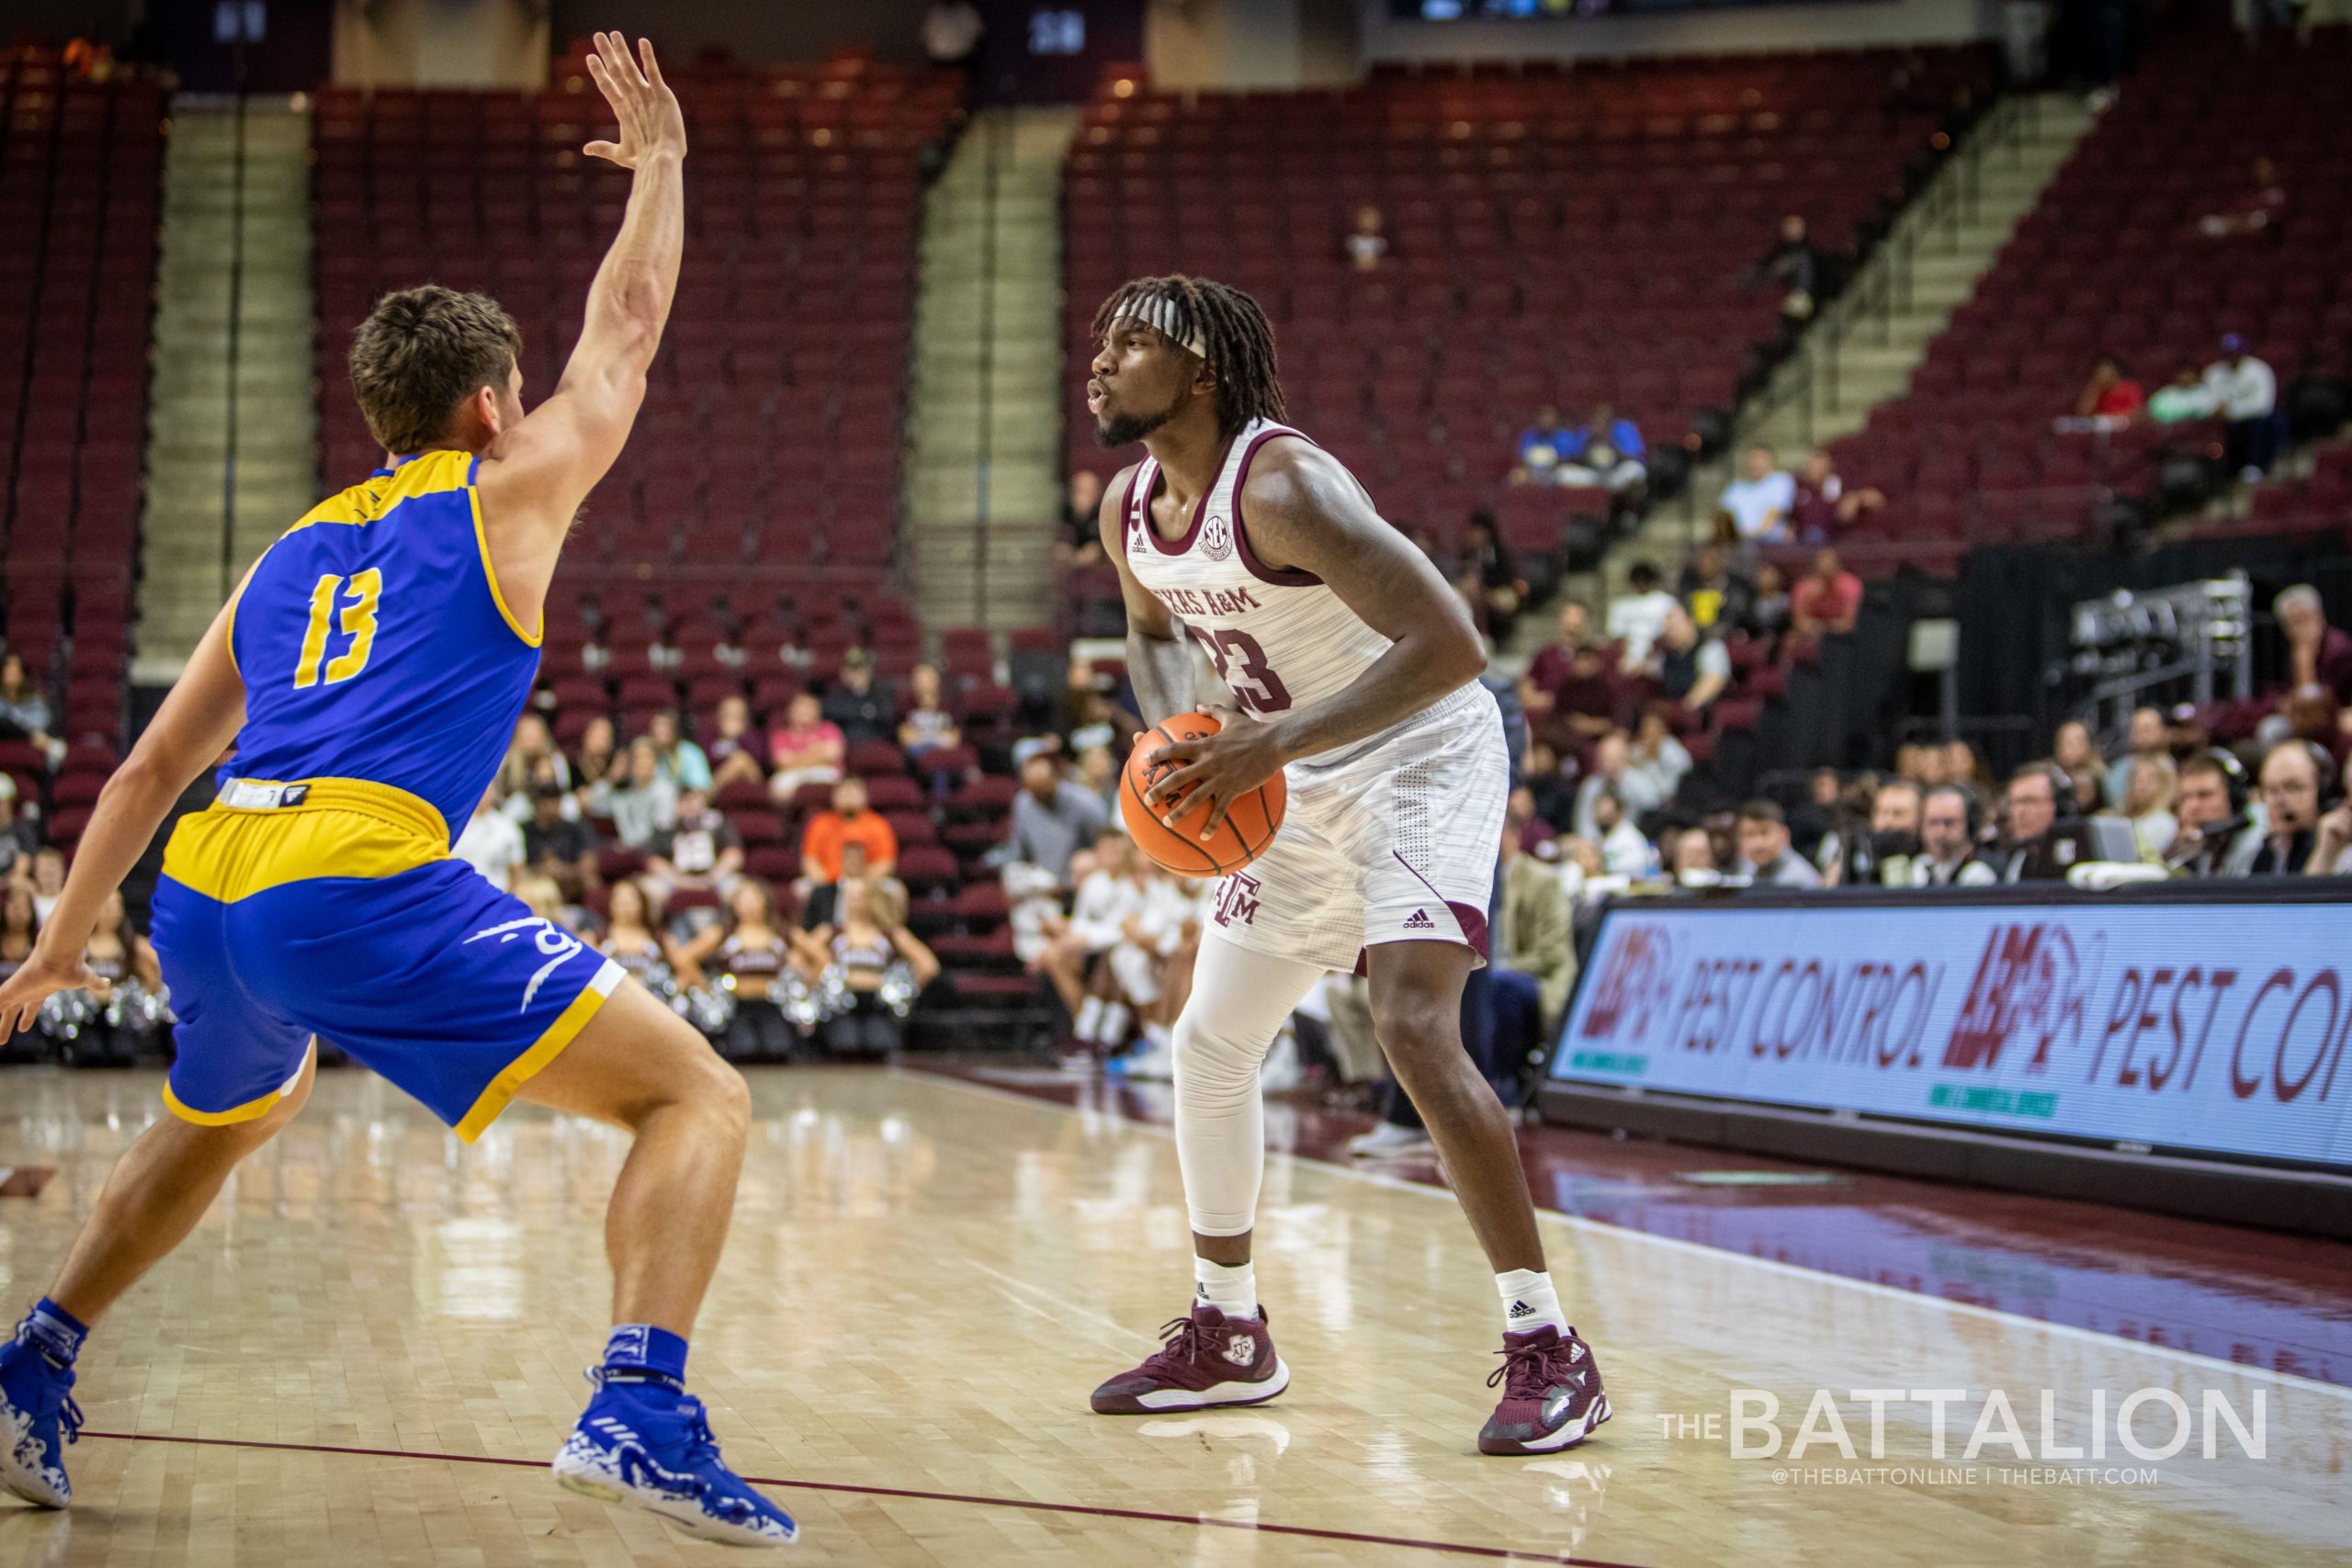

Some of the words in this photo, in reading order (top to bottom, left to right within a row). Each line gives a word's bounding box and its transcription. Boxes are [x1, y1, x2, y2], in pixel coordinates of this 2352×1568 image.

[1204, 516, 1228, 549] SEC
[1152, 589, 1206, 615] XAS
[1202, 586, 1261, 615] A&M
[293, 567, 382, 689] 13
[1403, 919, 1435, 929] adidas
[2087, 966, 2238, 1091] PEST
[1509, 1307, 1536, 1319] adidas
